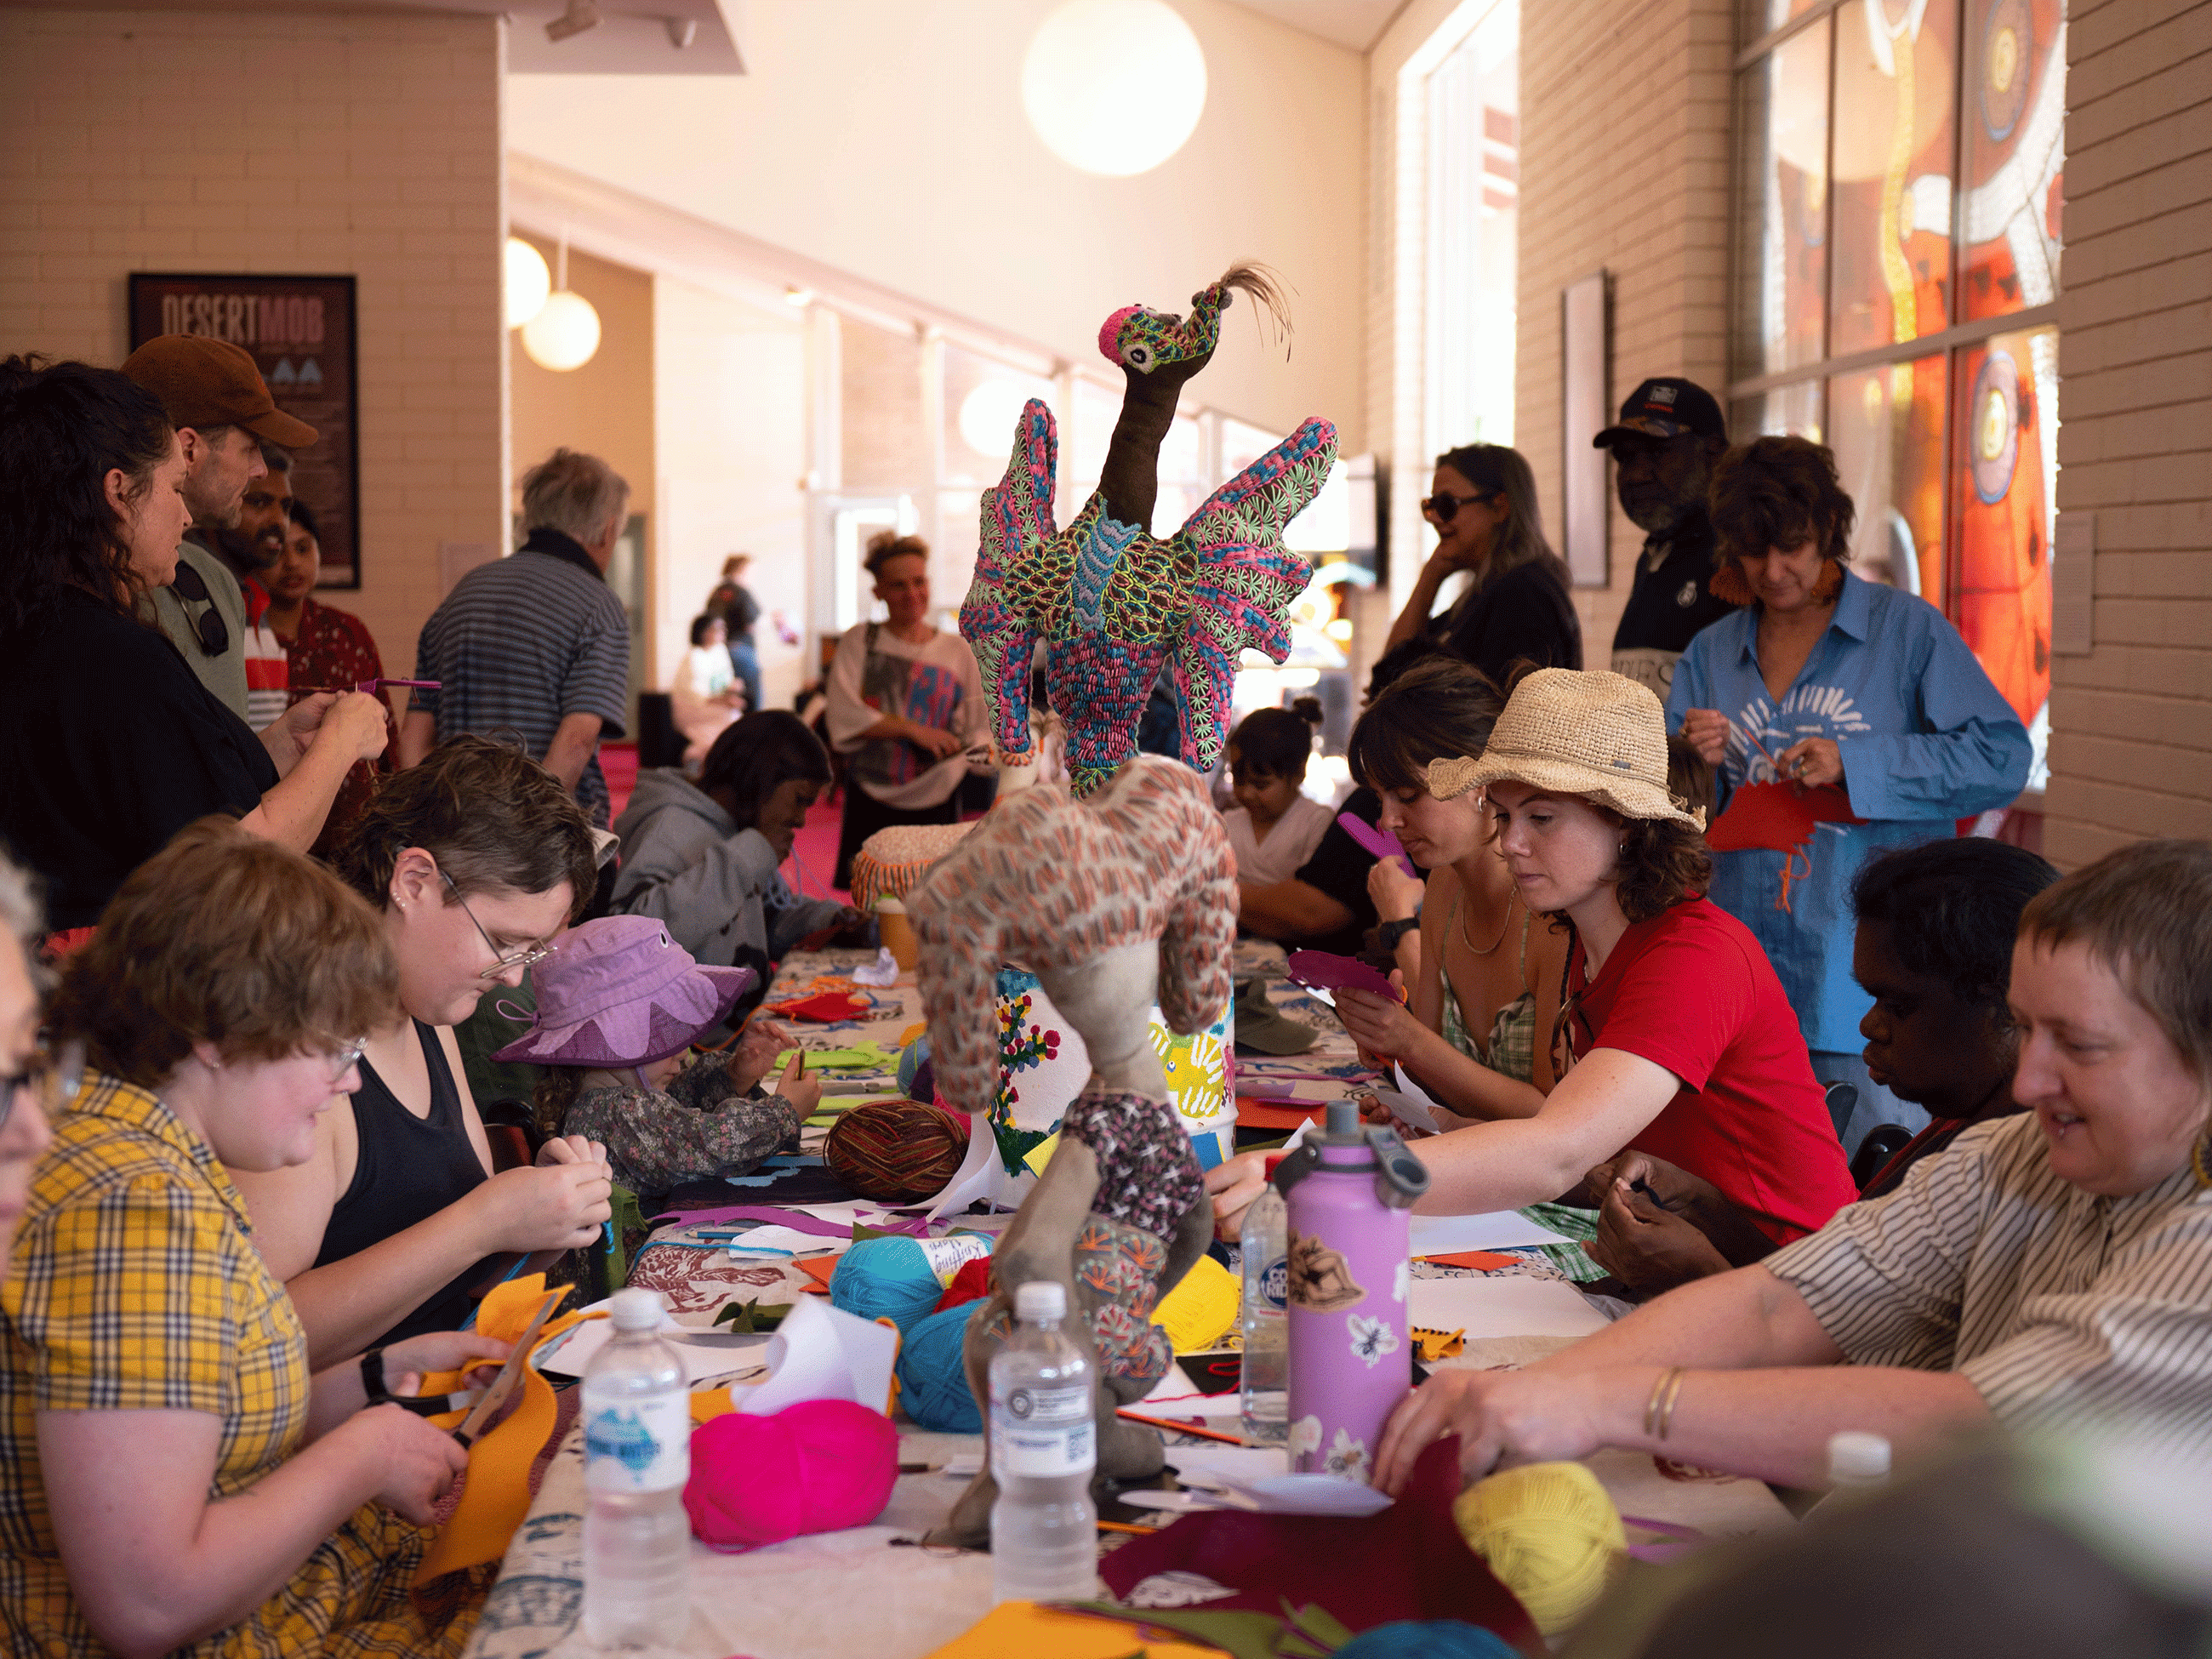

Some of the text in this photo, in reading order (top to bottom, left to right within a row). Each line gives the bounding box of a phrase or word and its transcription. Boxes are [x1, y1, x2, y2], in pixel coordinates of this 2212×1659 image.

[929, 1239, 961, 1251] Yarn
[935, 1241, 982, 1274] Knitting
[1268, 1268, 1288, 1284] CO
[1266, 1282, 1288, 1298] RID
